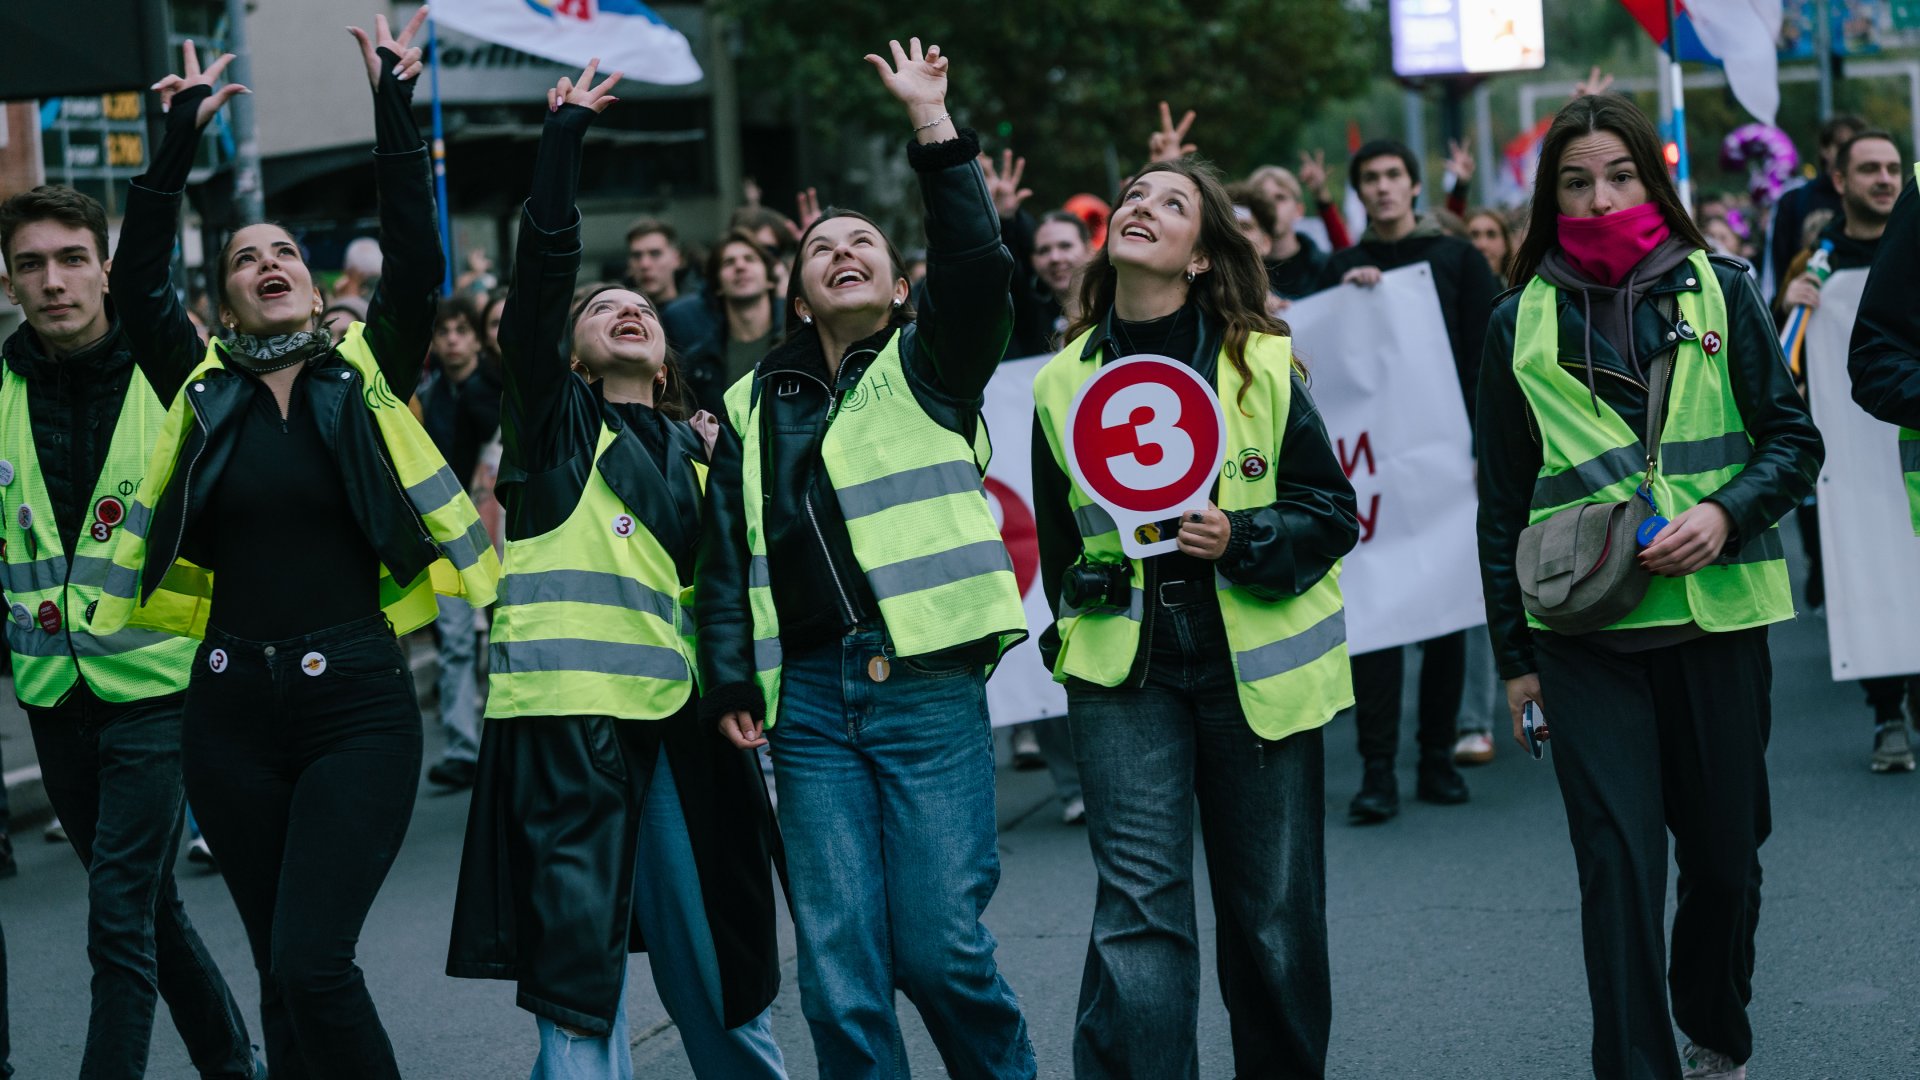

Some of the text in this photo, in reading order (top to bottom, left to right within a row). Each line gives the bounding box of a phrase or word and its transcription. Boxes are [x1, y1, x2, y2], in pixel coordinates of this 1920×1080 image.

[1704, 333, 1720, 352] 3
[1101, 382, 1195, 490] 3
[1245, 459, 1263, 476] 3
[94, 523, 108, 540] 3
[616, 516, 632, 535] 3
[211, 652, 223, 670] 3
